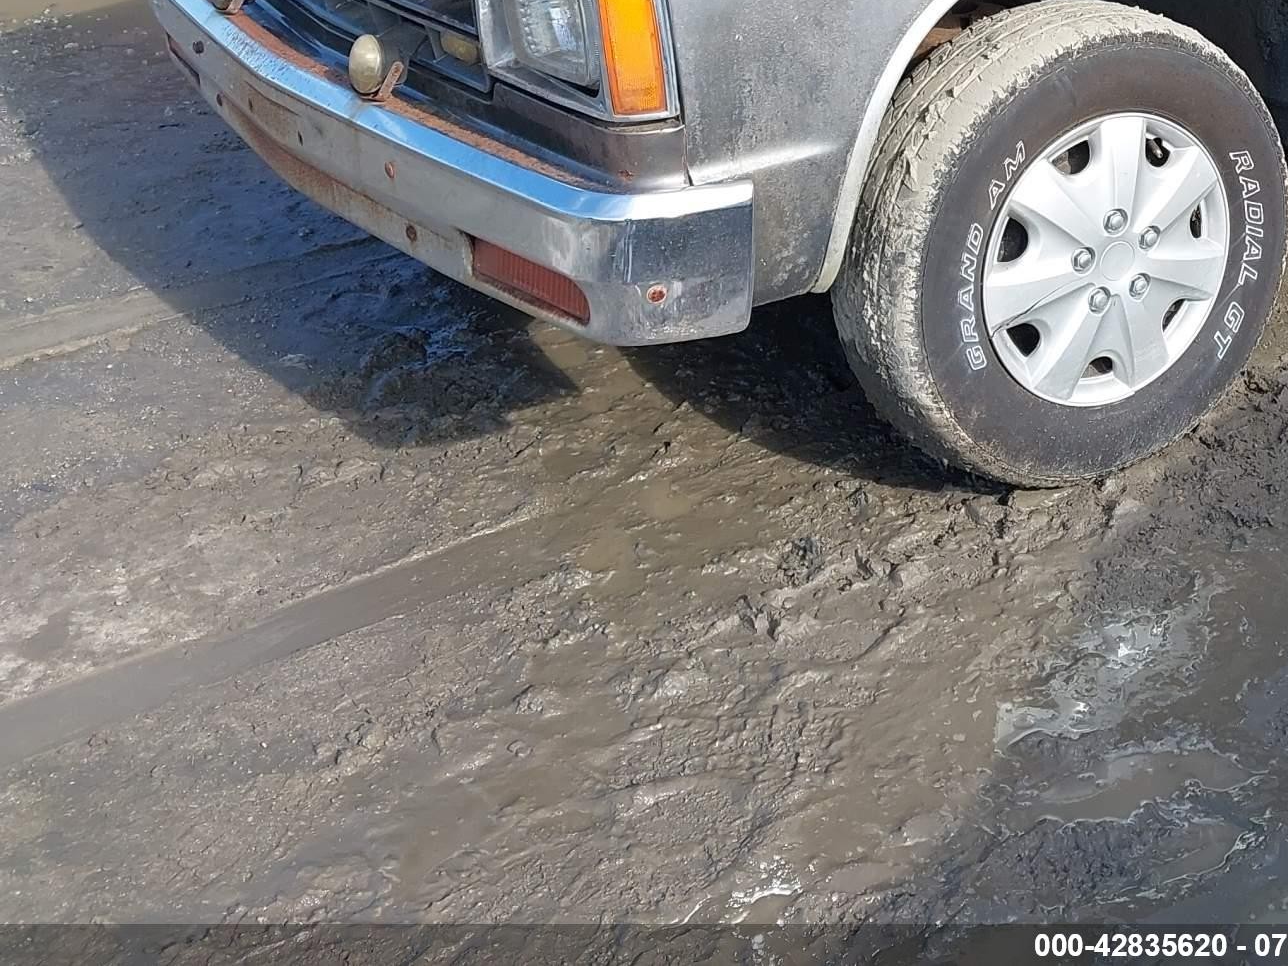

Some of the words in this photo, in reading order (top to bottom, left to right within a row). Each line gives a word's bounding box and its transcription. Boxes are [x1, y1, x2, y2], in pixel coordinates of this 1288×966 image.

[958, 222, 988, 371] GRAND
[988, 140, 1026, 210] AM
[1229, 150, 1264, 285] RADIAL
[1214, 301, 1245, 360] GT
